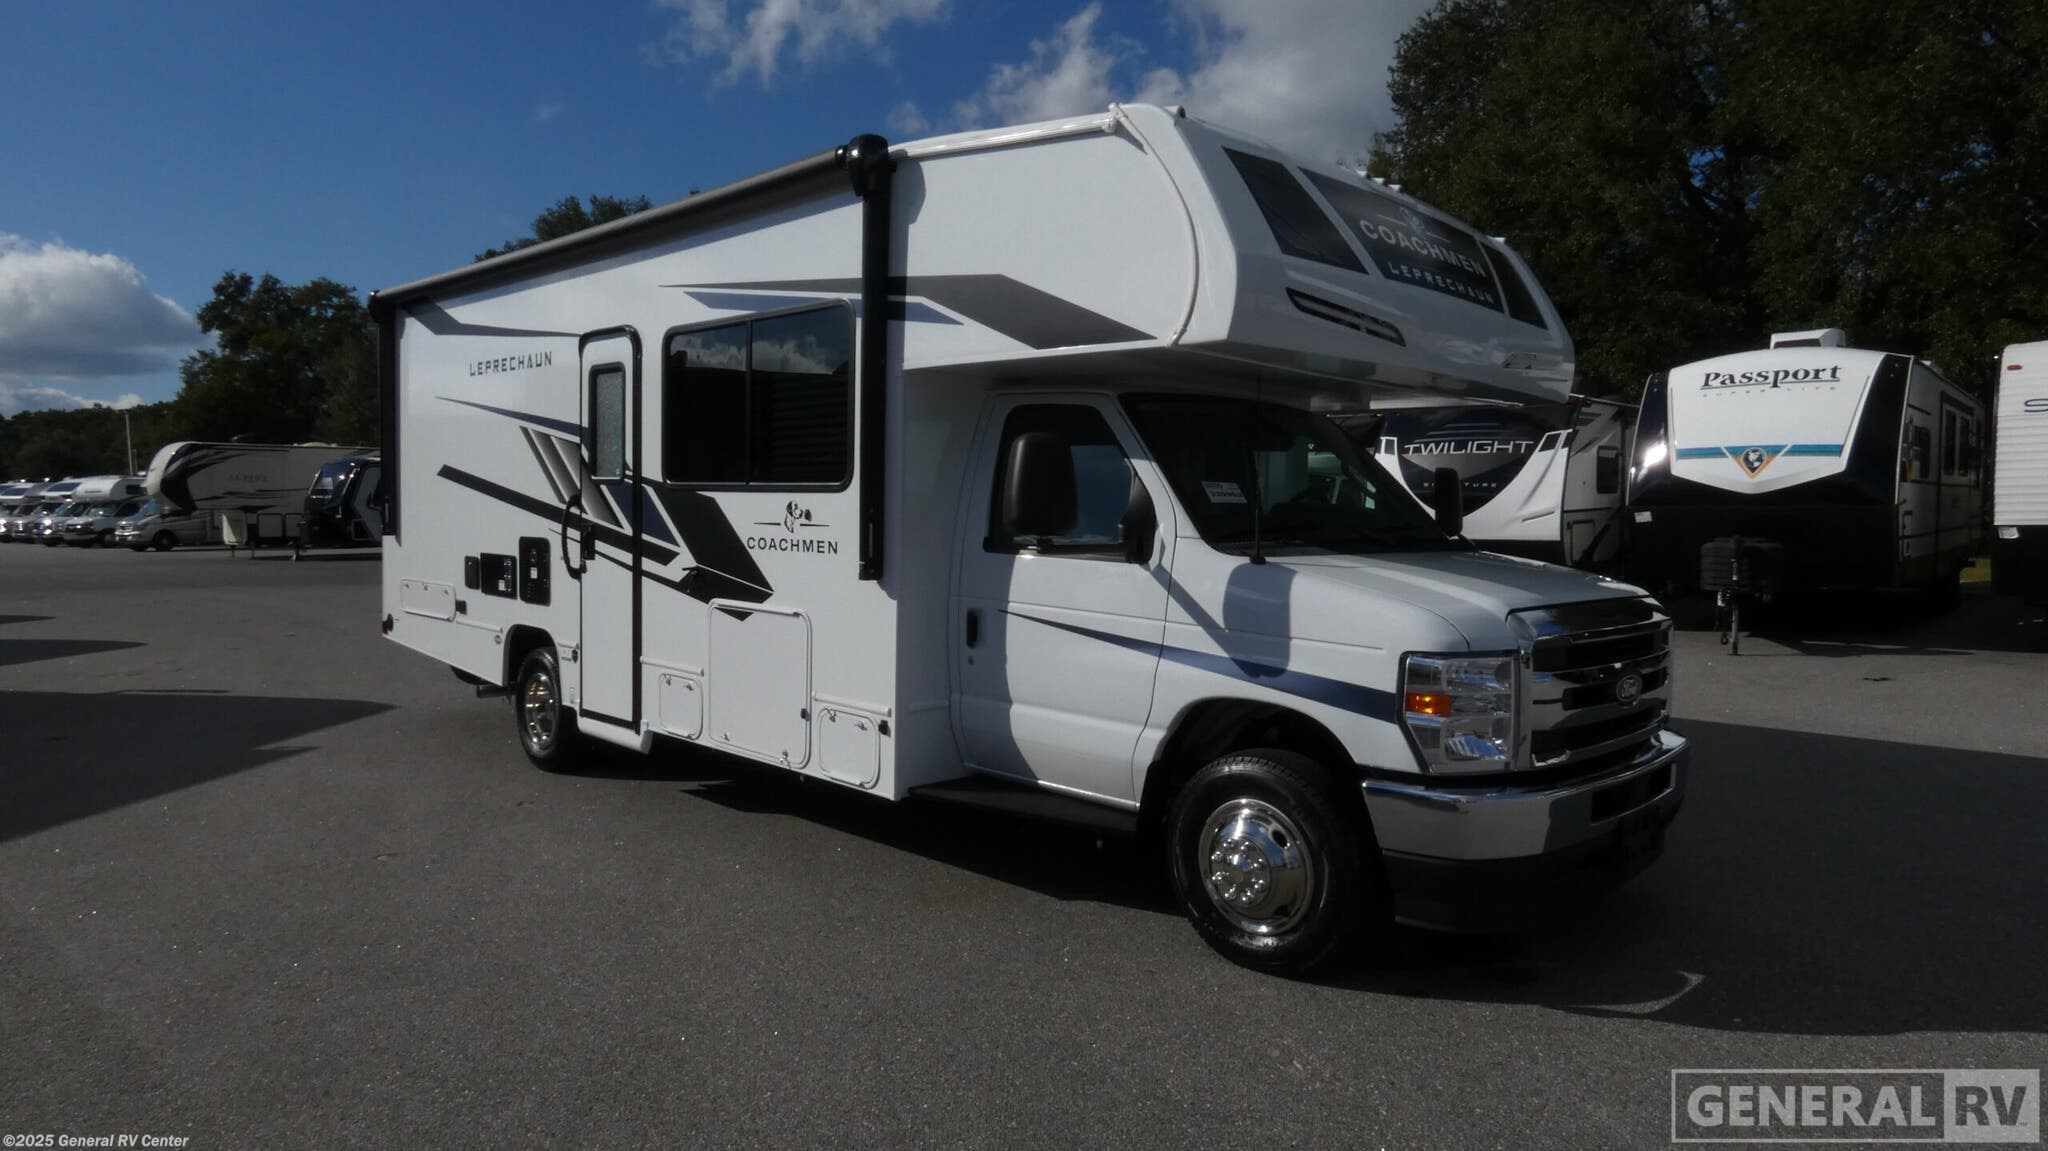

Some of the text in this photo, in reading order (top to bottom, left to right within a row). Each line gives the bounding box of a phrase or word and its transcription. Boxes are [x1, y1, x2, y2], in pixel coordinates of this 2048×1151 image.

[1359, 218, 1487, 279] COACHMEN
[1387, 260, 1494, 305] LEPRECHAUN
[470, 351, 552, 376] LEPRECHAUN
[1703, 365, 1841, 388] Passport
[1404, 440, 1534, 456] TWILIGHT
[747, 537, 838, 554] COACHMEN
